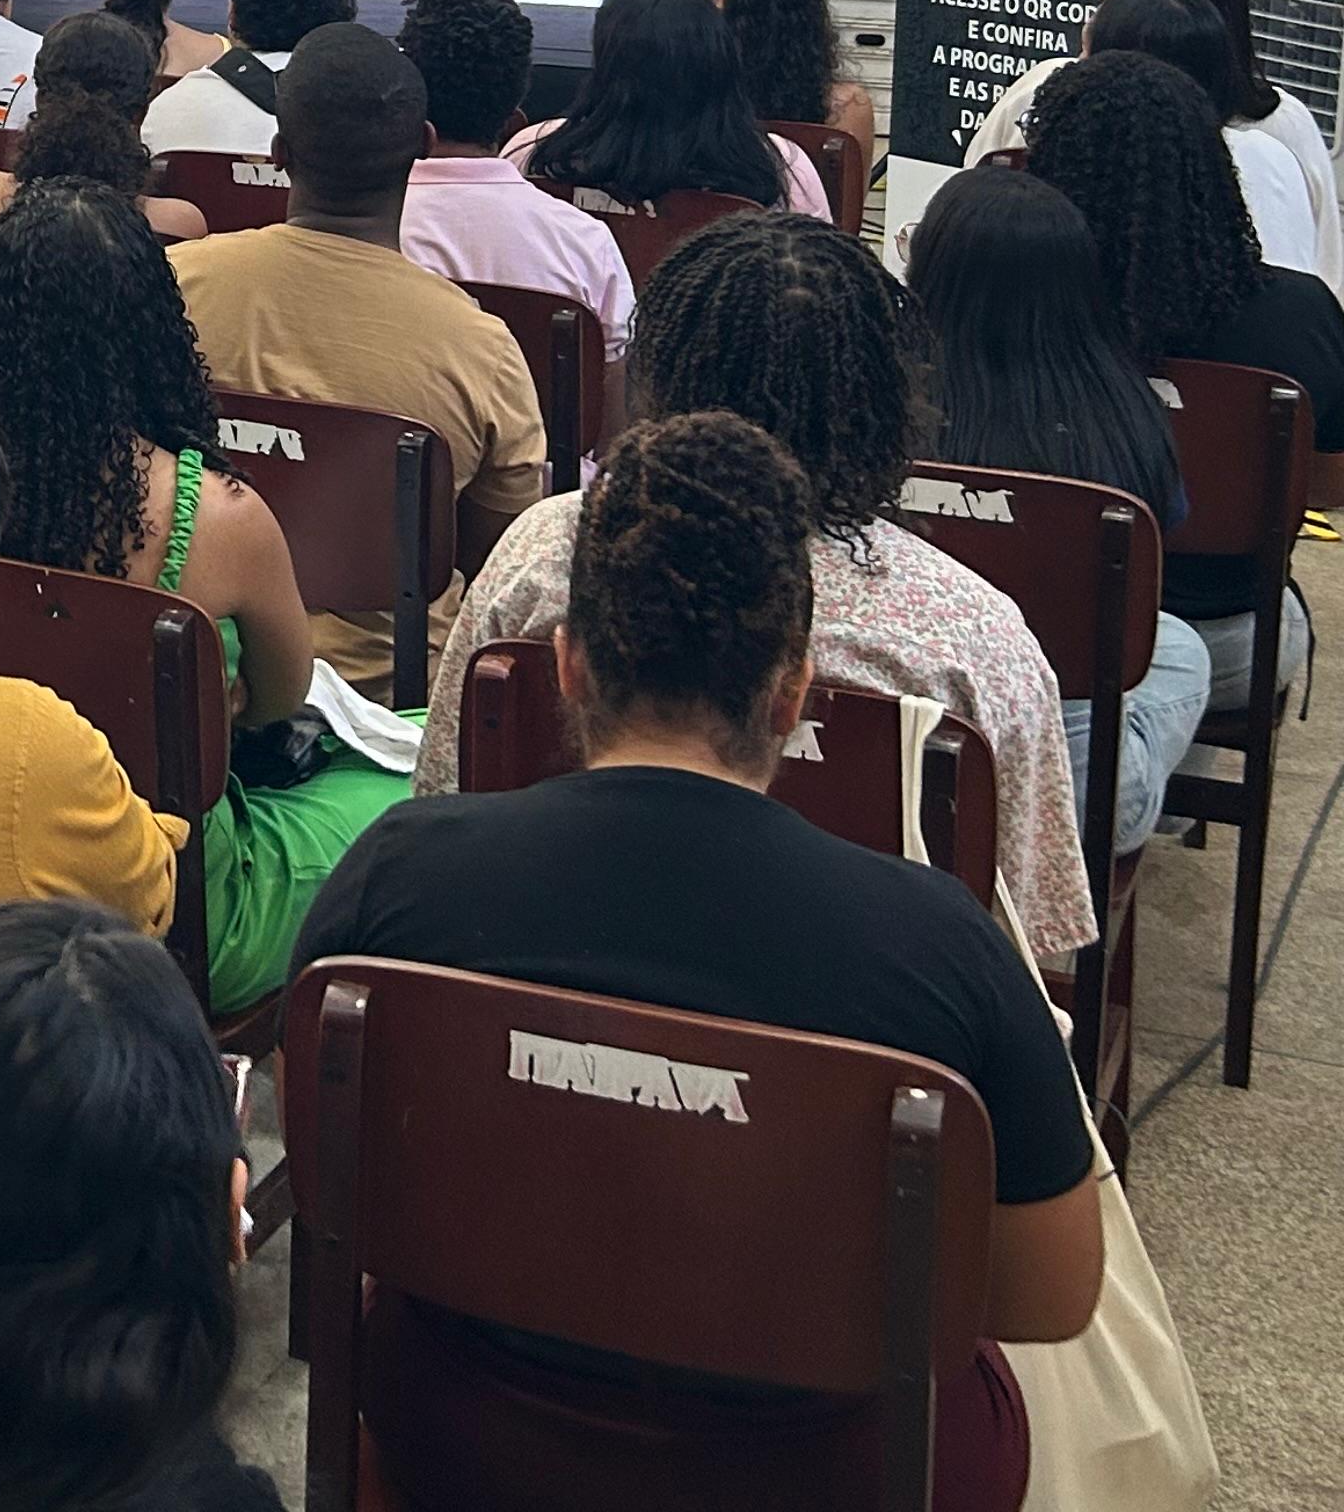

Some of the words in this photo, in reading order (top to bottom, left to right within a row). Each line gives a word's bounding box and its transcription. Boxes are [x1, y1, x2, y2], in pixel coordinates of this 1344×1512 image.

[1055, 1, 1098, 24] COD
[967, 19, 980, 39] E
[982, 22, 1069, 53] CONFIRA
[932, 45, 946, 64] A
[949, 77, 961, 97] E
[963, 79, 988, 102] AS
